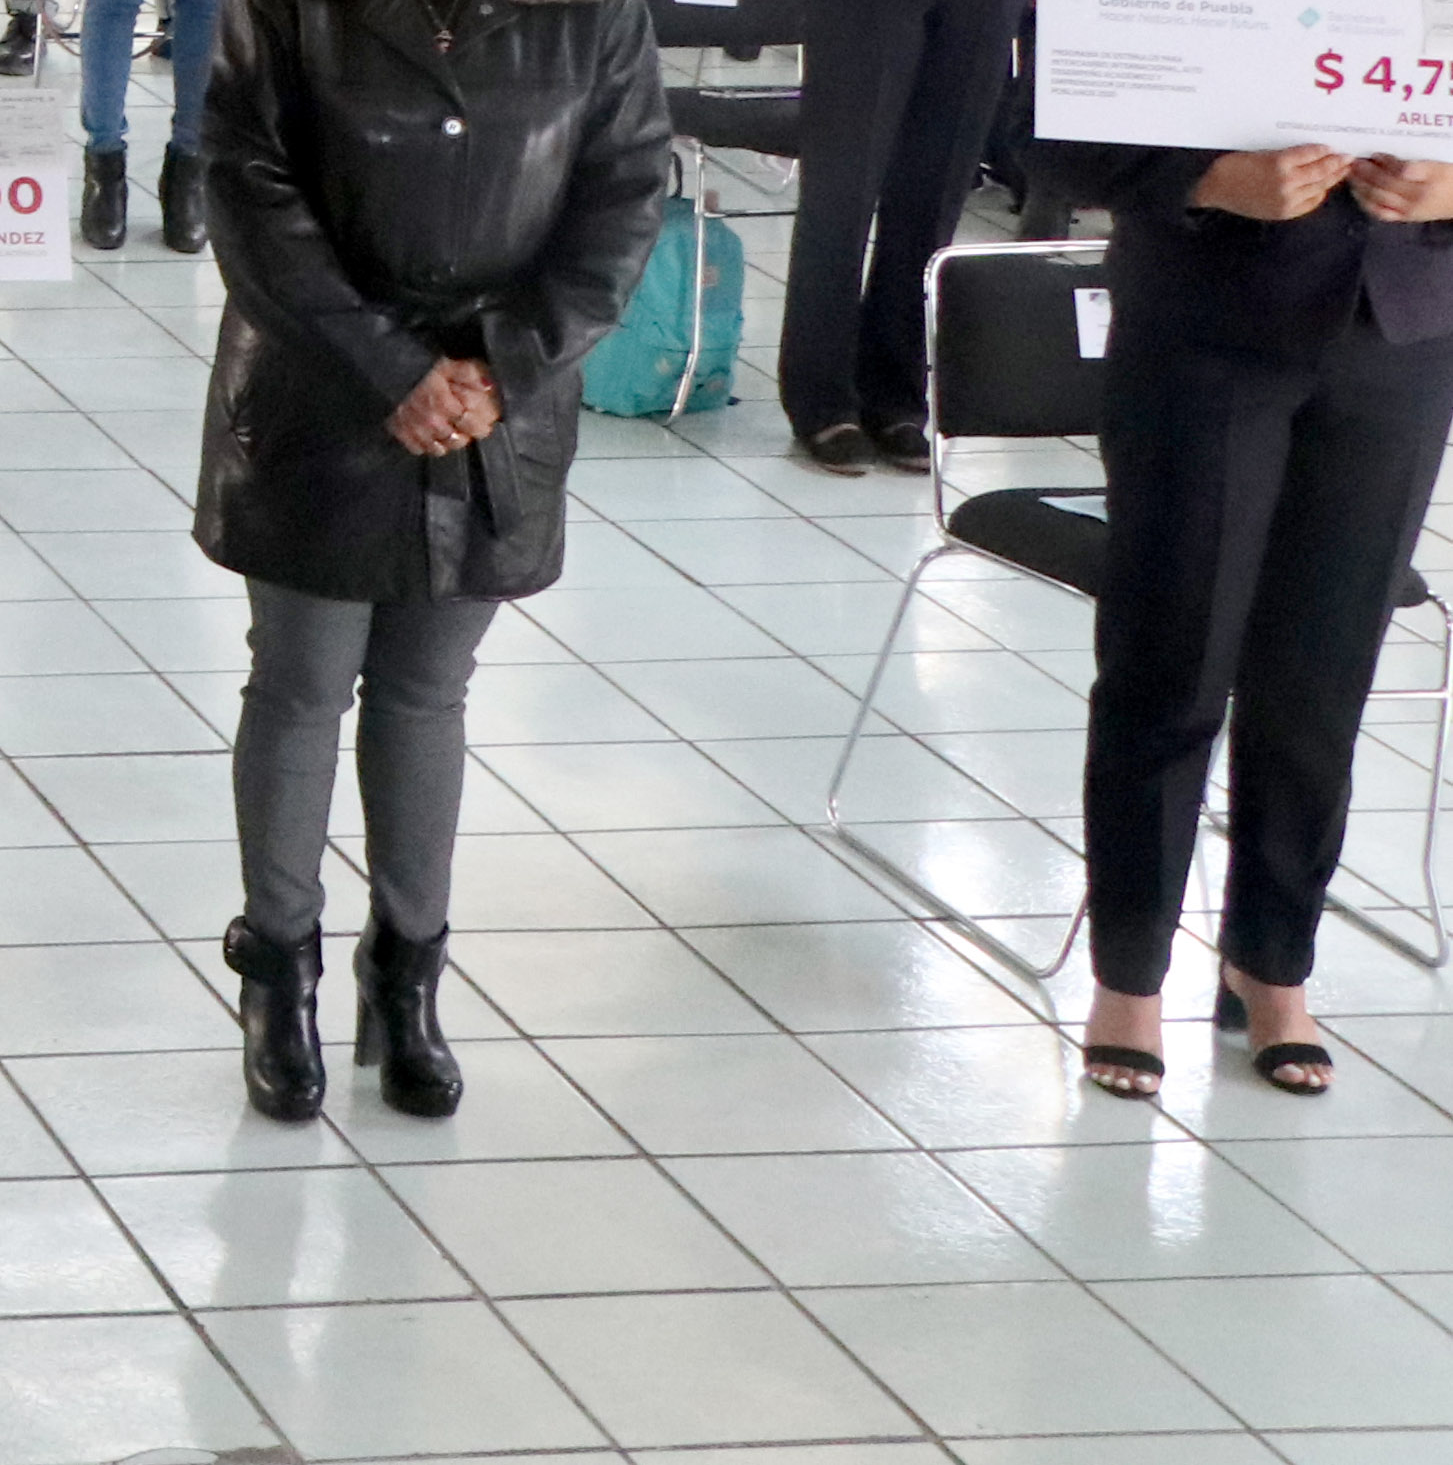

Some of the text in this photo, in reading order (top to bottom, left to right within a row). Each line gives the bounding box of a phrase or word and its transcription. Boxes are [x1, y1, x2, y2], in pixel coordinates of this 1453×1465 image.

[1199, 0, 1254, 15] Puebla
[1314, 48, 1453, 102] $ 4,7
